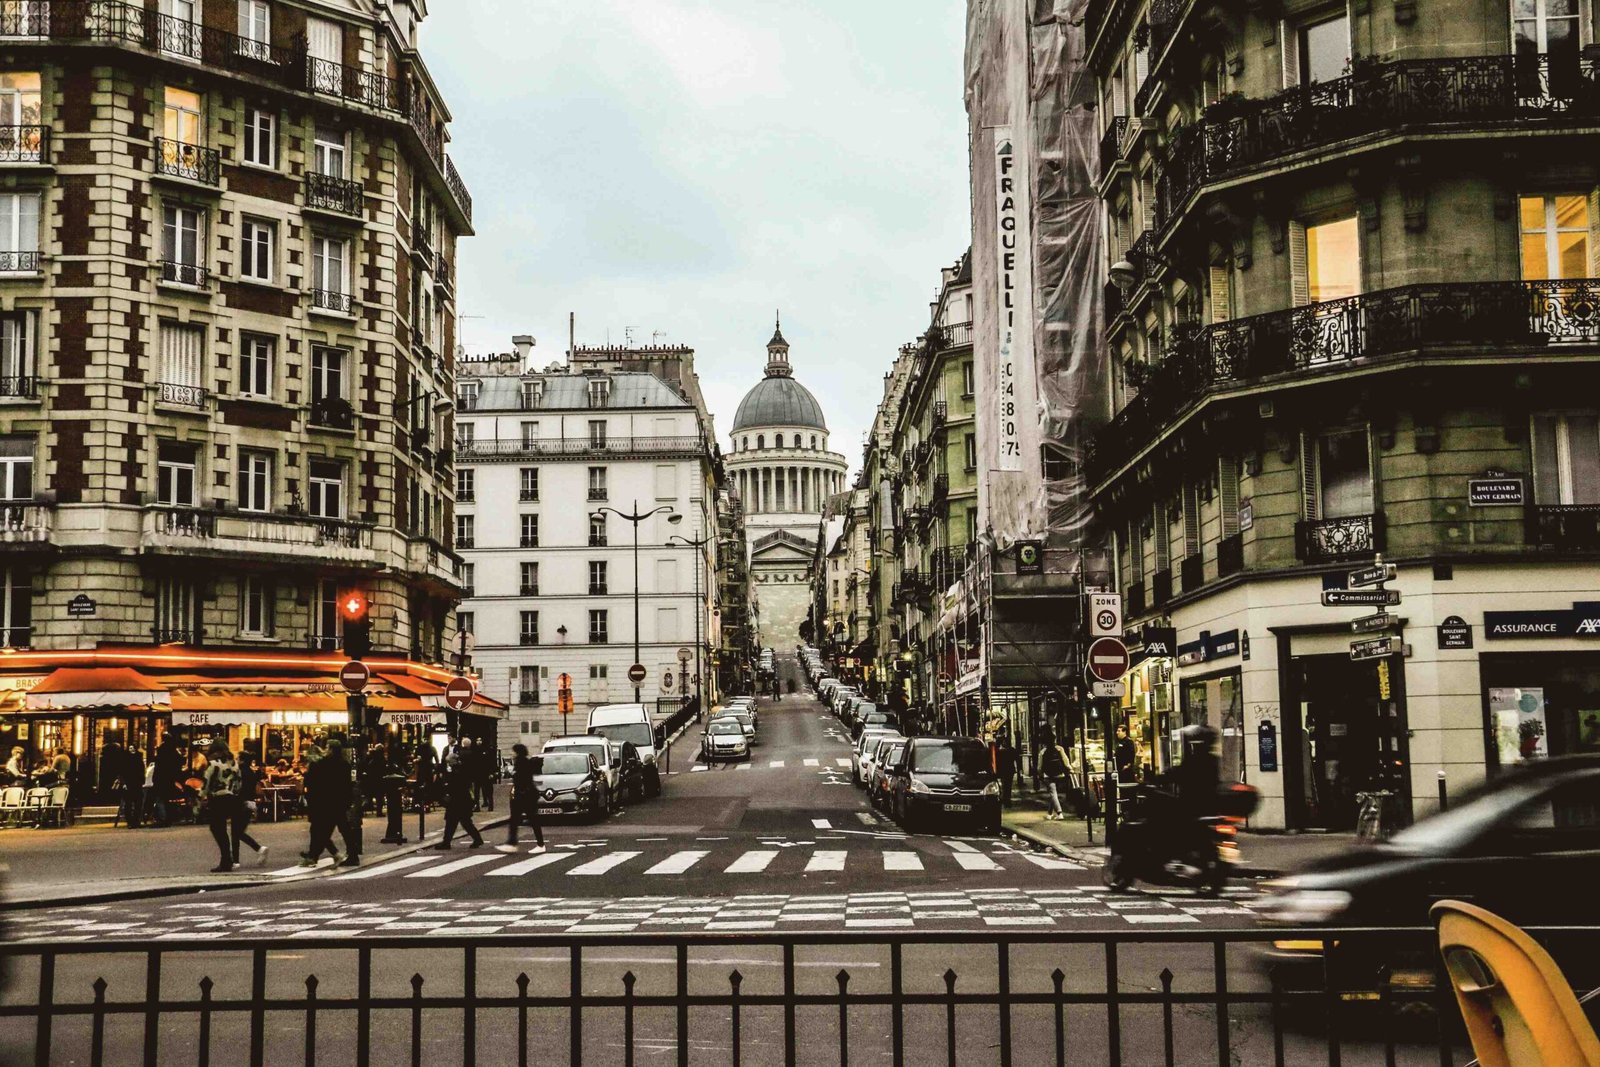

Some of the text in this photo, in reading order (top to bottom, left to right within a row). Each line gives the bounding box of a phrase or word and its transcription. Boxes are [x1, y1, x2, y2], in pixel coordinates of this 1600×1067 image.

[1001, 157, 1016, 327] FRAQUELLI
[1096, 598, 1117, 606] ZONE
[1100, 615, 1113, 625] 30
[1493, 623, 1557, 633] ASSURANCE
[1576, 618, 1600, 633] AXA
[1145, 642, 1168, 654] AXA
[189, 713, 209, 723] CAFE
[391, 714, 432, 724] RESTAURANT
